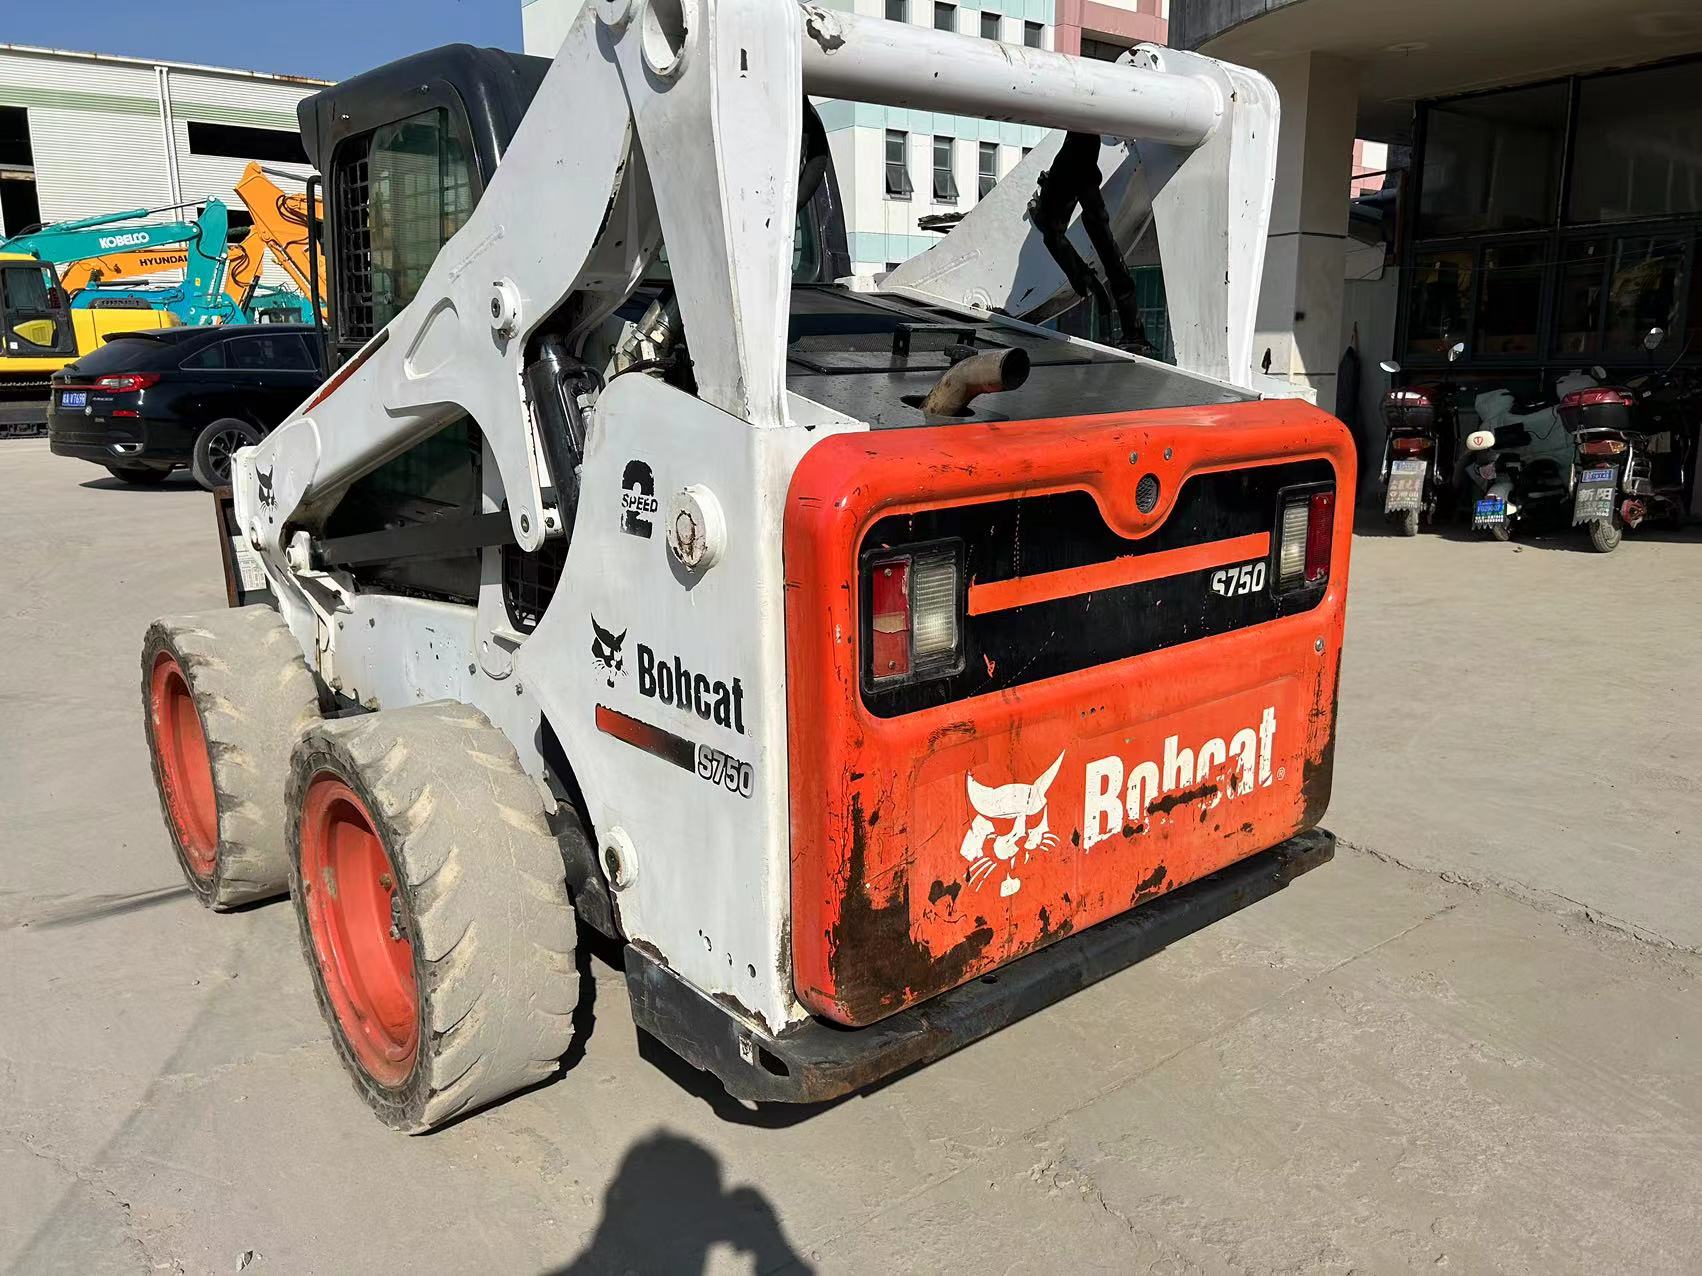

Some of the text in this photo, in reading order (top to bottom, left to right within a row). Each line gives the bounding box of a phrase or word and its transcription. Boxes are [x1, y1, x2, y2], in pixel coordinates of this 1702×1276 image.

[99, 232, 150, 248] KOBELCO
[140, 255, 187, 267] HYUNDAI
[621, 493, 658, 513] SPEED
[1212, 562, 1266, 597] S750
[637, 643, 745, 736] Bobcat
[698, 744, 754, 799] S750
[1083, 706, 1277, 854] Bobcat
